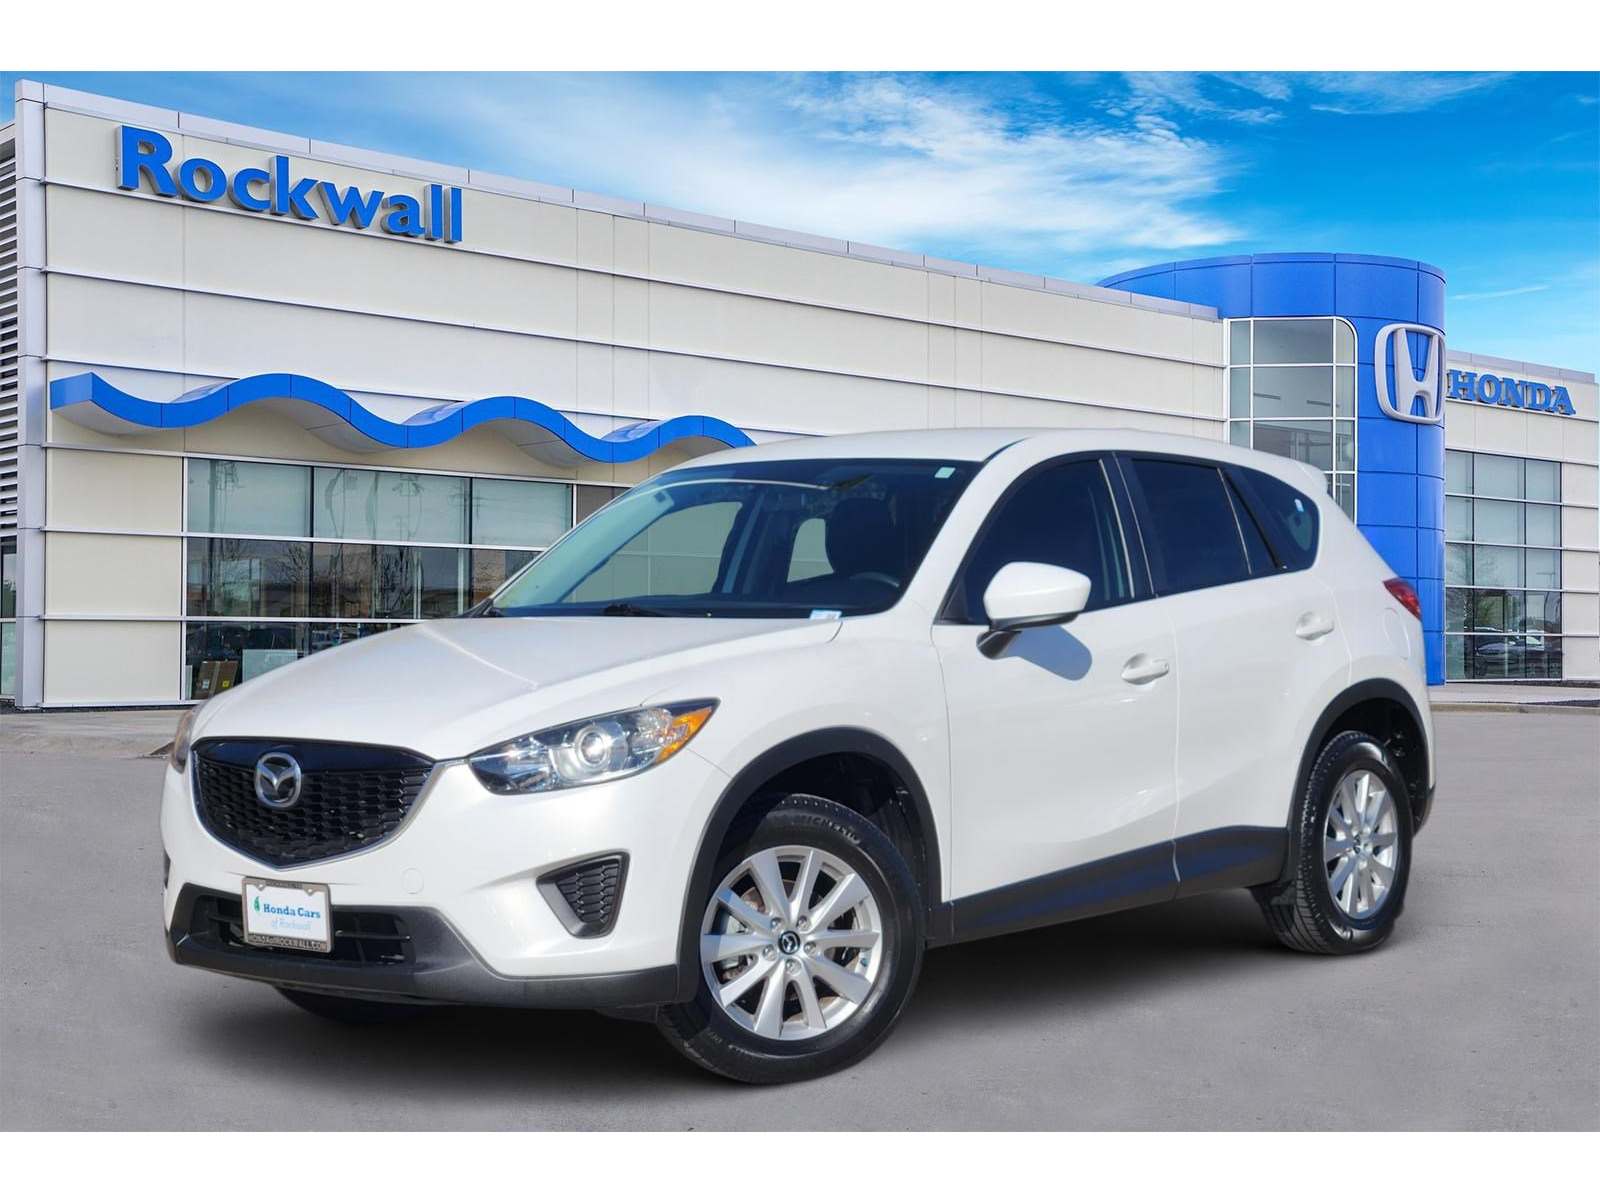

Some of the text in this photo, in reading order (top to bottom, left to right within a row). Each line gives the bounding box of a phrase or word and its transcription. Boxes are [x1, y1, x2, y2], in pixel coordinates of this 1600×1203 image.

[116, 124, 463, 244] Rockwall
[1446, 369, 1576, 416] HONDA
[263, 903, 321, 919] Honda Cars
